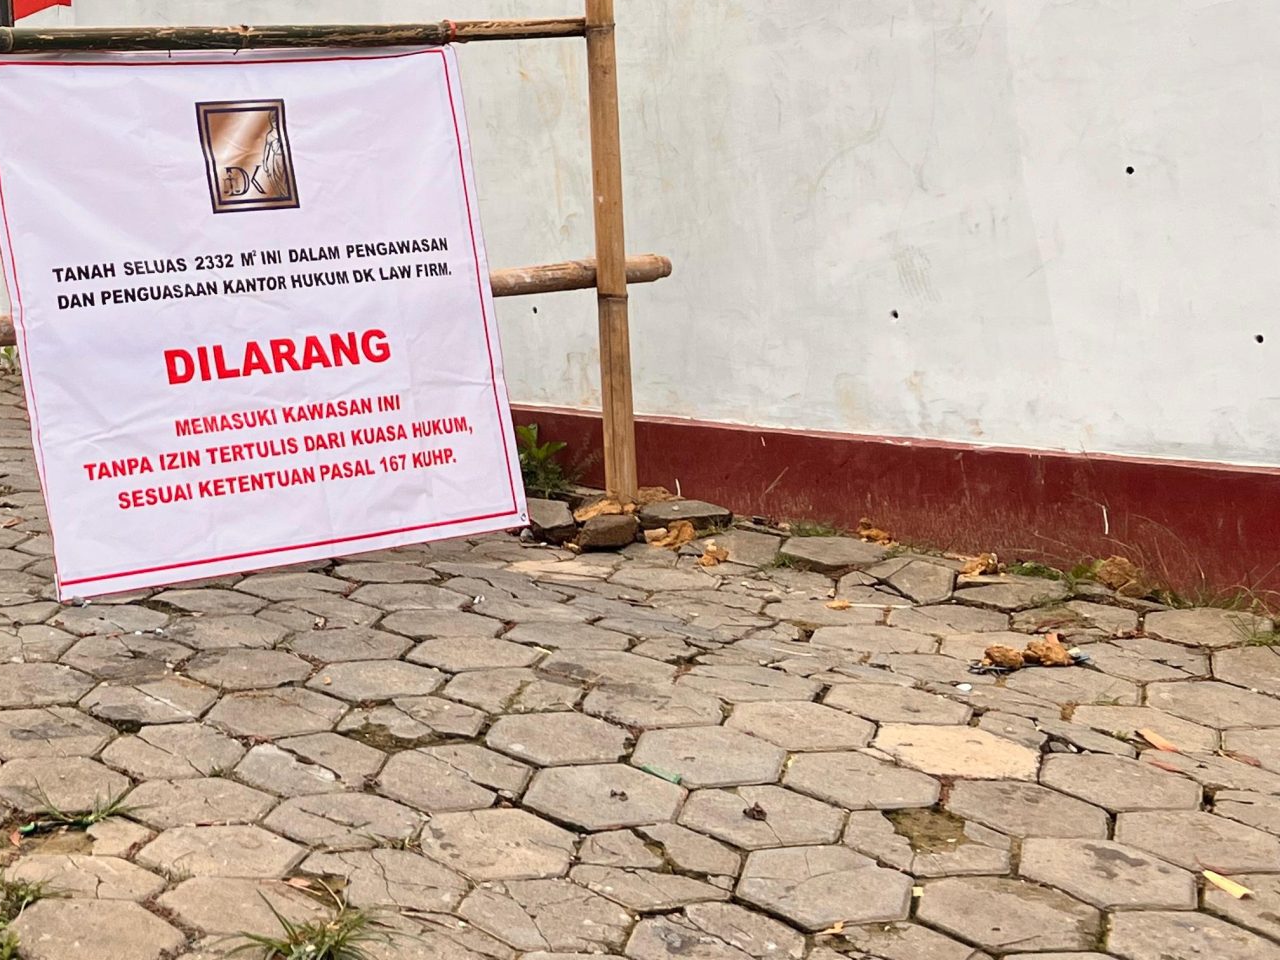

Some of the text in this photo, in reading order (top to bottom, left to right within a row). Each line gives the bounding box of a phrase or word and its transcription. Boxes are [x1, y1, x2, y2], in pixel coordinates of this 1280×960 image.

[52, 263, 116, 282] TANAH
[123, 258, 187, 276] SELUAS
[195, 254, 234, 270] 2332
[261, 250, 282, 265] INI
[289, 246, 340, 263] DALAM
[346, 238, 448, 258] PENGAWASAN
[57, 262, 452, 309] DAN PENGUASAAN KANTOR HUKUM DK LAW FIRM.
[164, 329, 391, 385] DILARANG
[175, 394, 401, 437] MEMASUKI KAWASAN INI
[83, 416, 473, 481] TANPA IZIN TERTULIS DARI KUASA HUKUM,
[118, 448, 456, 510] SESUAI KETENTUAN PASAL 167 KUHP.
